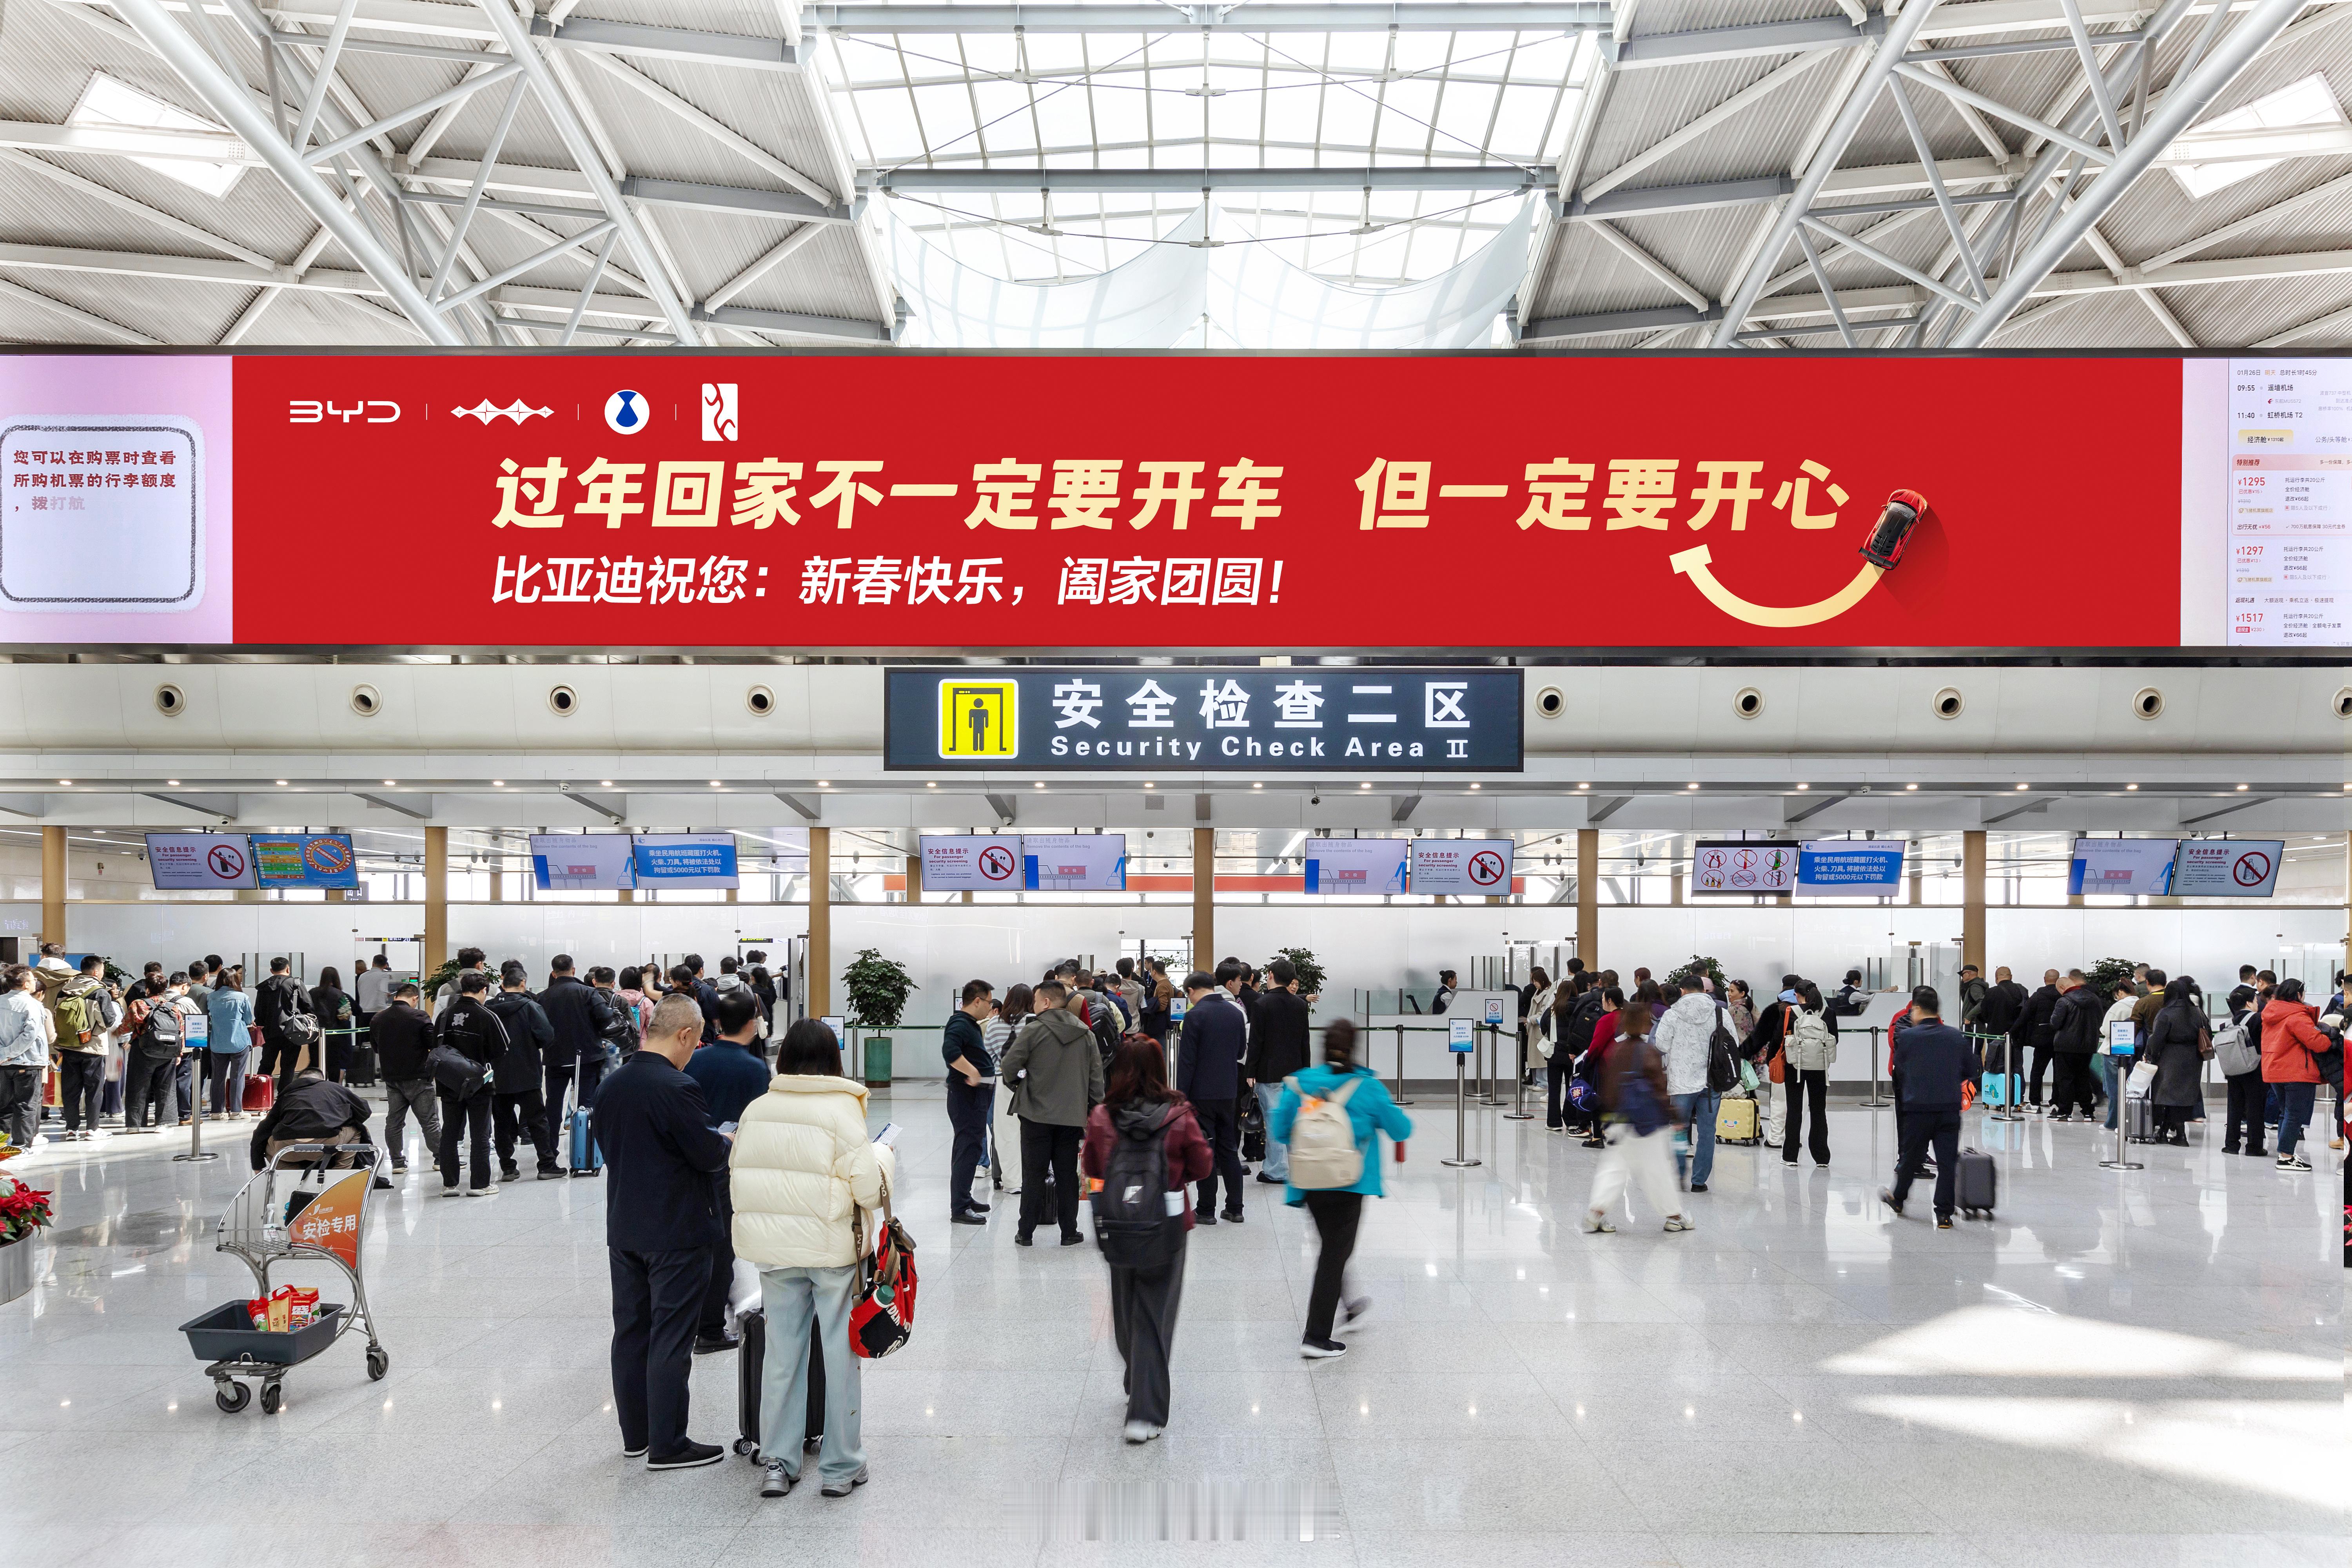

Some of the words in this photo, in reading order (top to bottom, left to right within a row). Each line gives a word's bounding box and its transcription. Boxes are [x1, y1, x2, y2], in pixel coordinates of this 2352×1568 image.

[290, 401, 401, 423] BYD
[14, 450, 176, 465] 您可以在购票时查看
[13, 473, 176, 488] 所购机票的行李额度
[2238, 477, 2265, 486] ¥1295
[492, 457, 1284, 530] 过年回家不一定要开车
[1355, 457, 1849, 531] 但一定要开心
[2236, 546, 2263, 555] ¥1297
[2236, 613, 2263, 622] ¥1517
[1052, 678, 1470, 729] 安全检查二区
[1051, 736, 1201, 760] Security
[1221, 736, 1325, 756] Check
[1345, 737, 1423, 757] Area
[303, 1214, 356, 1240] 安检专用
